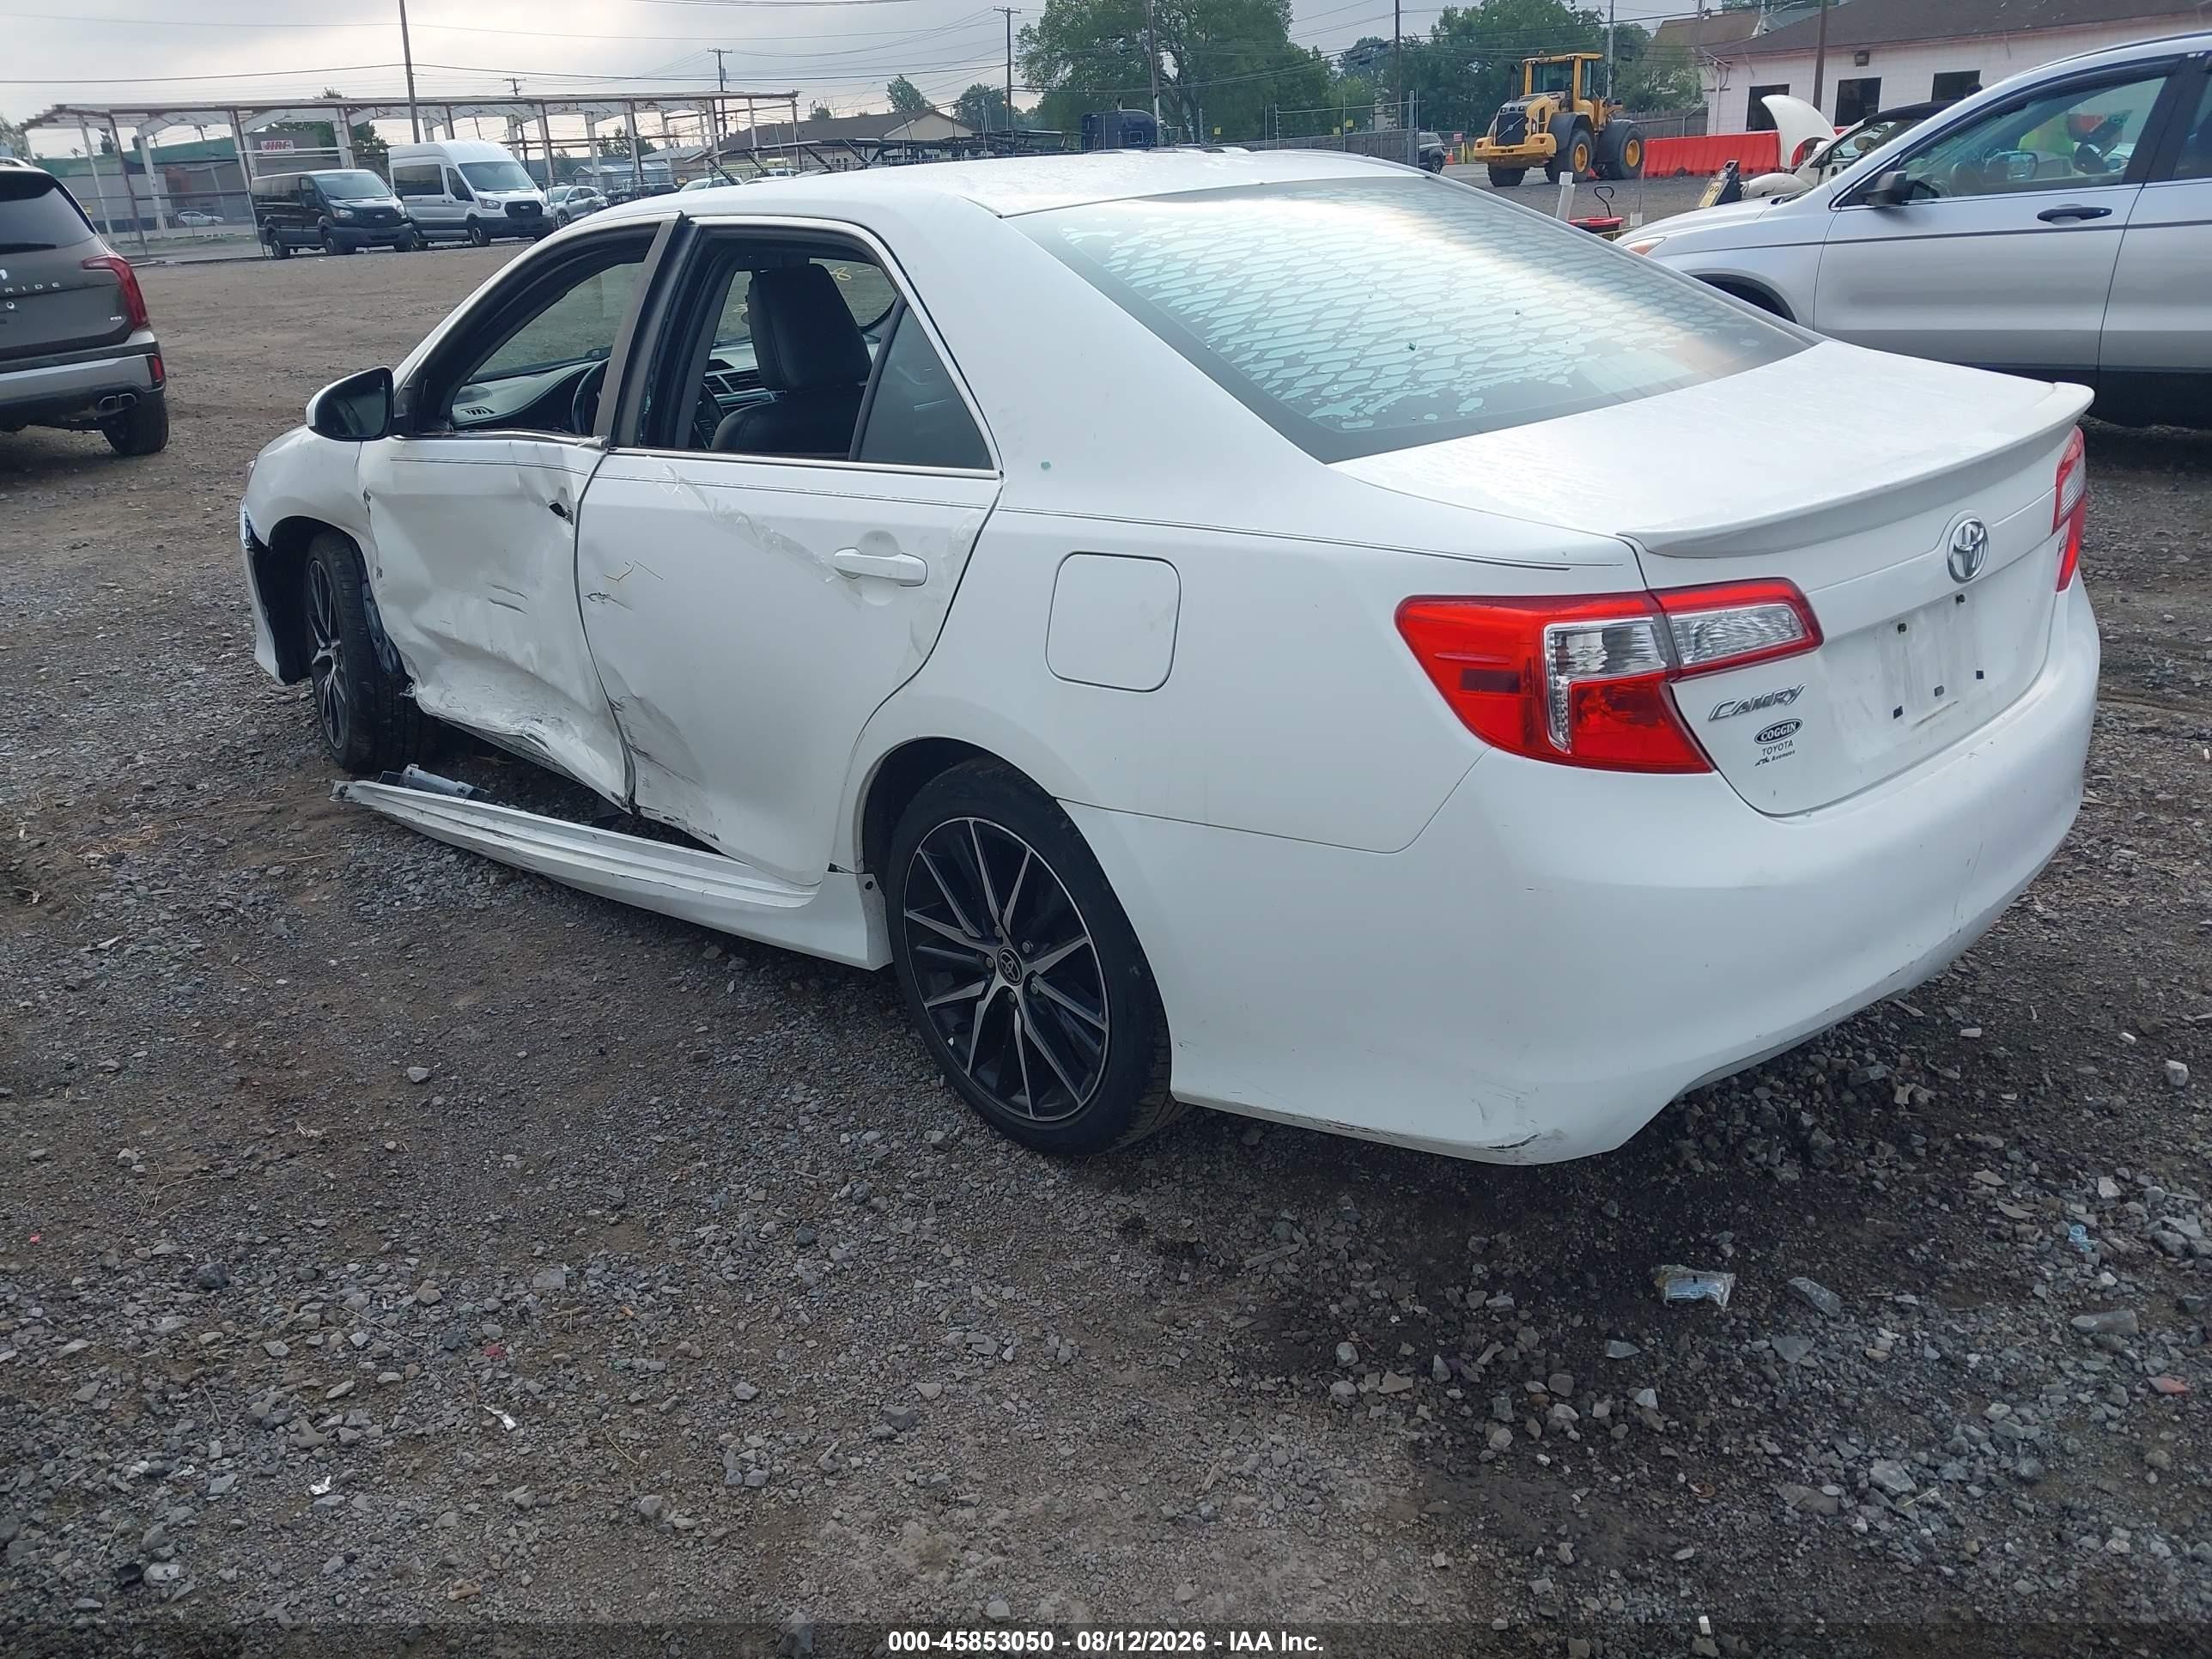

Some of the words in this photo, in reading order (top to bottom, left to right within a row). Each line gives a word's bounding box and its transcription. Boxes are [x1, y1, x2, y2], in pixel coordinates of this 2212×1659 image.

[1709, 683, 1807, 721] CAMRY
[1760, 721, 1797, 741] COGGIN
[1761, 739, 1794, 756] TOYOTA
